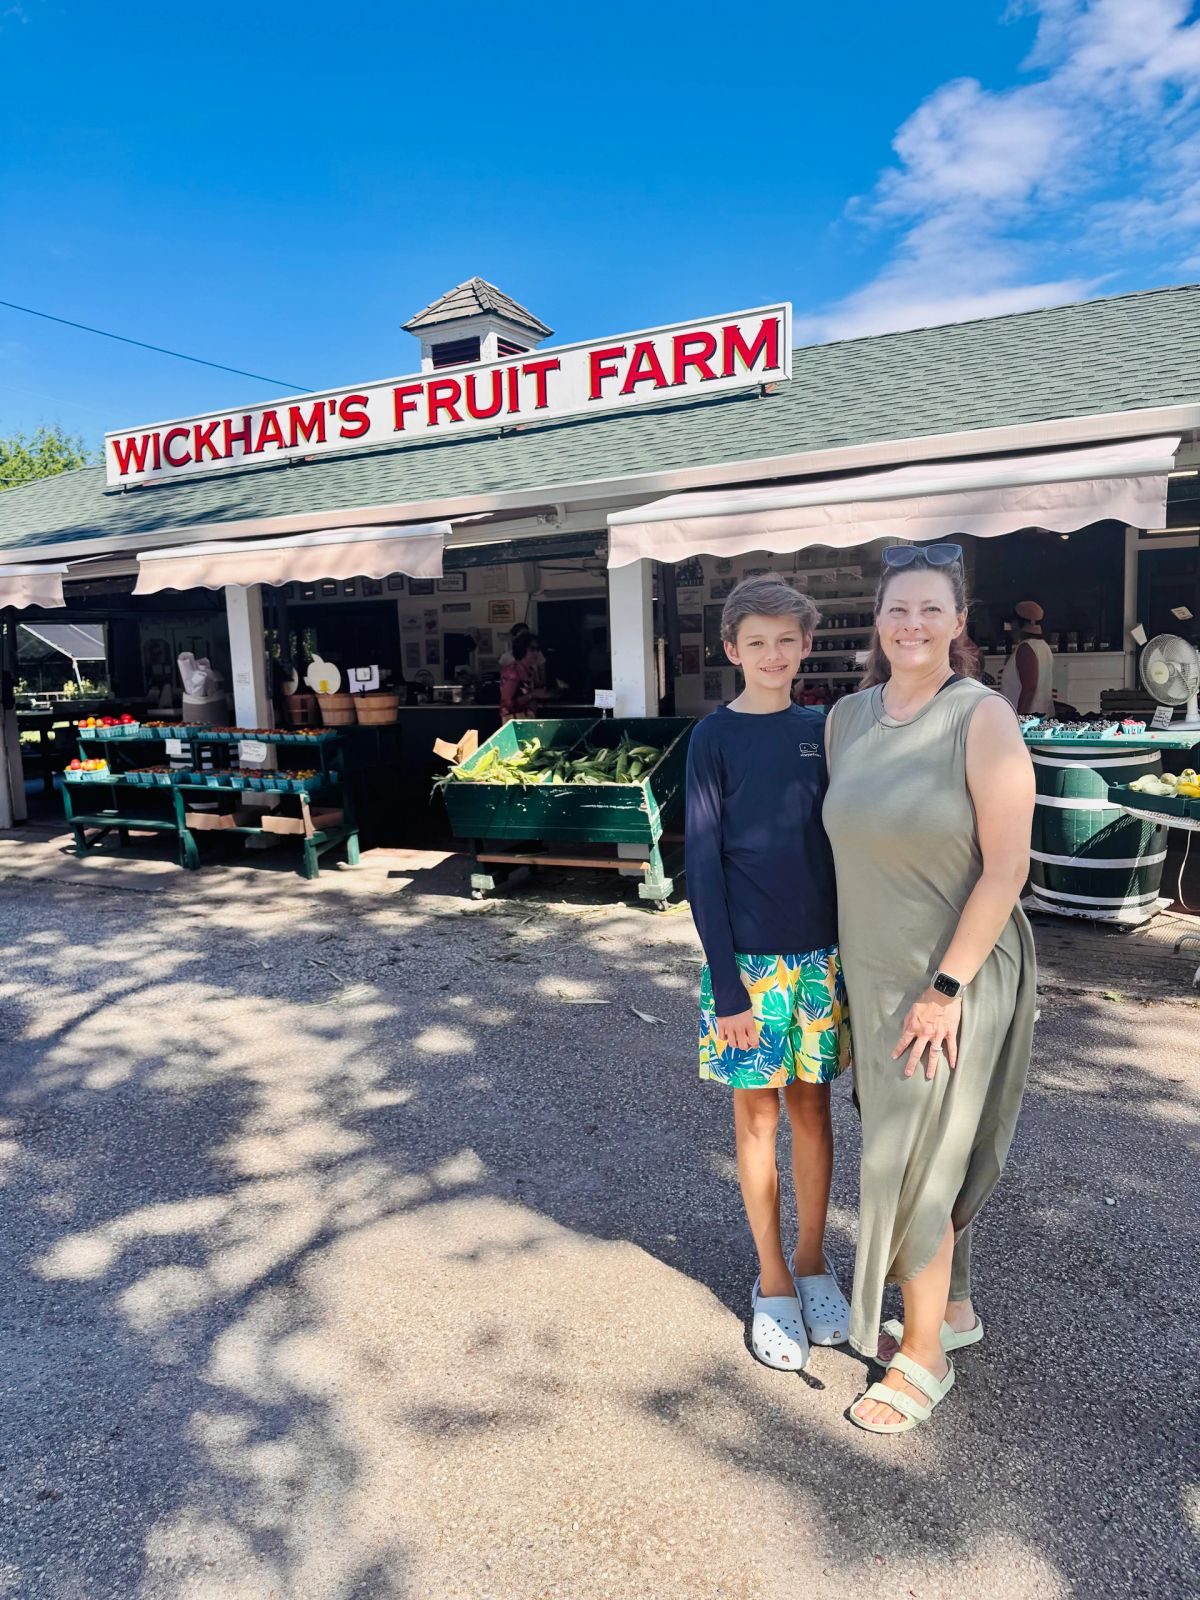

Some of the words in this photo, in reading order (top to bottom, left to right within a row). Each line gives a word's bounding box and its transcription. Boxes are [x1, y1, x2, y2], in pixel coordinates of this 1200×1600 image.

[111, 394, 371, 476] WICKHAM'S
[393, 358, 562, 432] FRUIT
[588, 317, 779, 400] FARM
